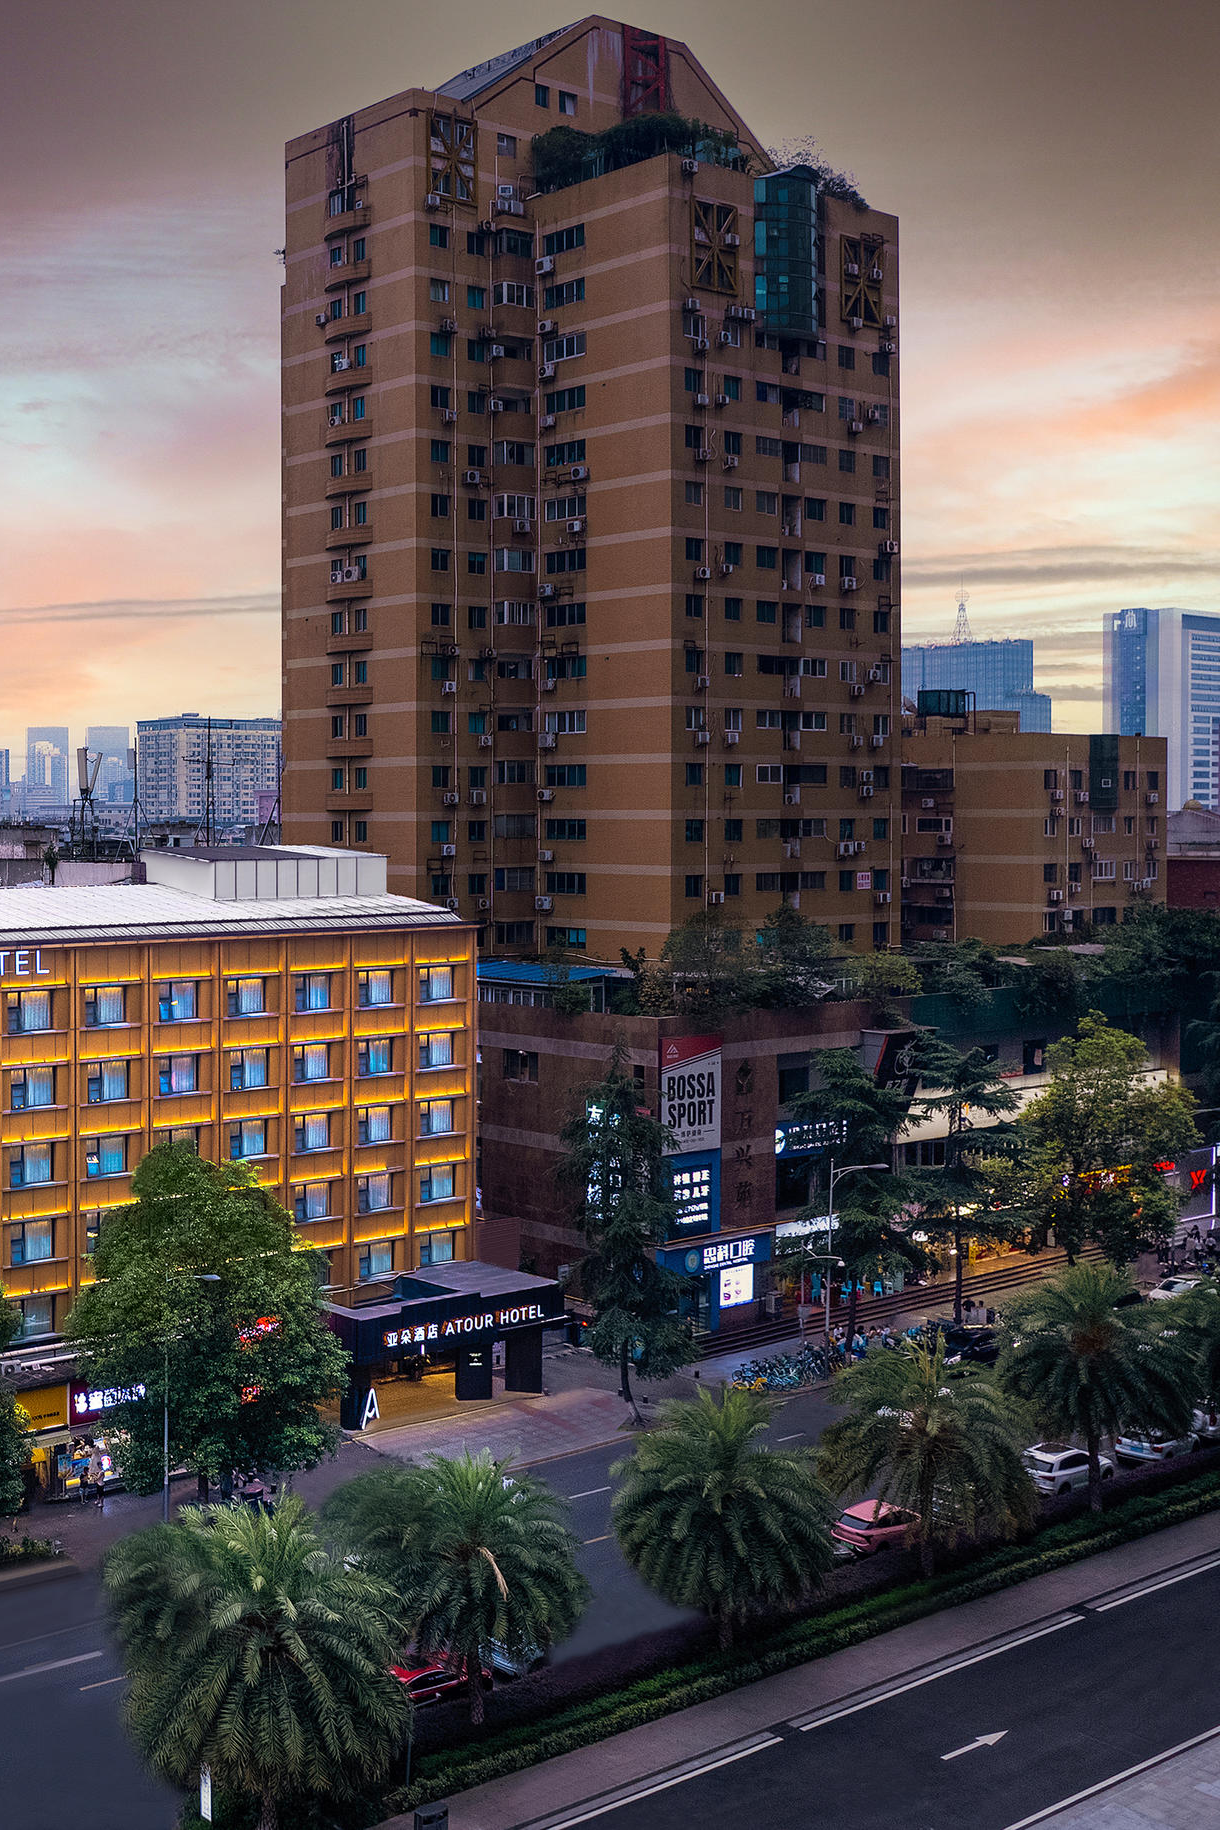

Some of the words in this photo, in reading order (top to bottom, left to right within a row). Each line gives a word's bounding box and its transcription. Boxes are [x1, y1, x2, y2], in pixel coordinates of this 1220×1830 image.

[667, 1071, 716, 1102] BOSSA
[668, 1099, 715, 1130] SPORT
[386, 1323, 439, 1348] 亚朵酒店
[445, 1313, 494, 1337] ATOUR
[499, 1304, 545, 1325] HOTEL
